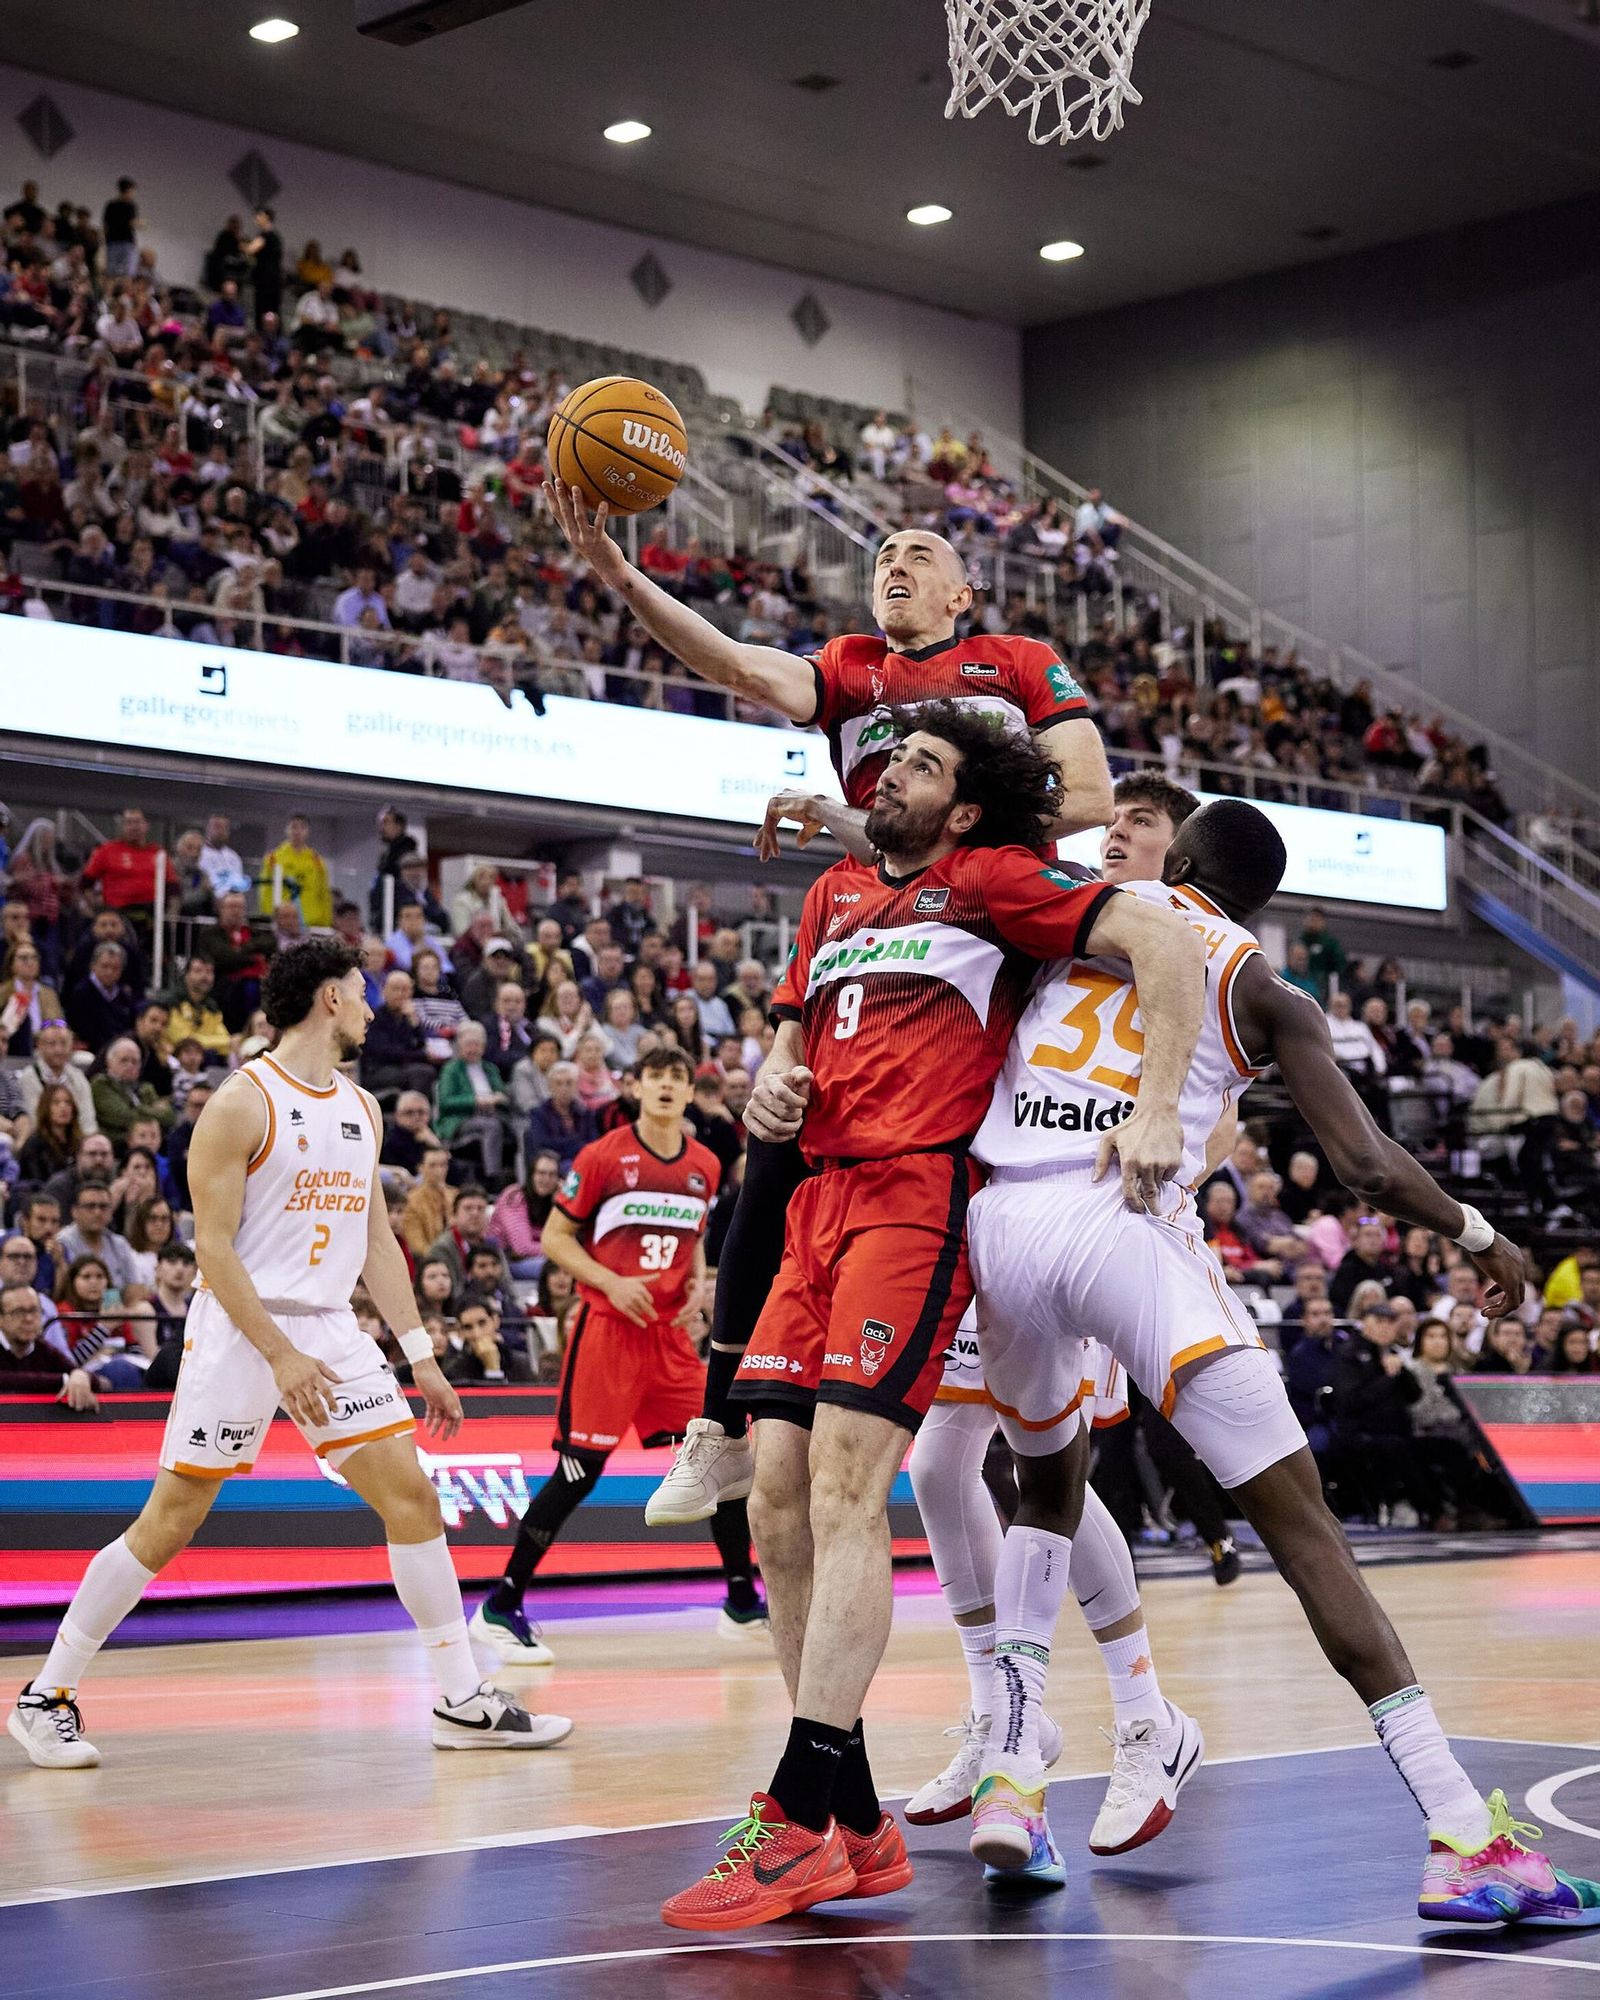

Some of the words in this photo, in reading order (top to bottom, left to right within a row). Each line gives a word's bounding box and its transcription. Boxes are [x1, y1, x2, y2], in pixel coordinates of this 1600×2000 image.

[622, 419, 687, 471] Wilson
[834, 983, 864, 1040] 9
[284, 1189, 367, 1213] Esfuerzo
[309, 1223, 331, 1266] 2
[639, 1233, 679, 1271] 33
[865, 1327, 887, 1340] acb
[742, 1355, 788, 1370] asisa
[343, 1393, 395, 1417] Midea
